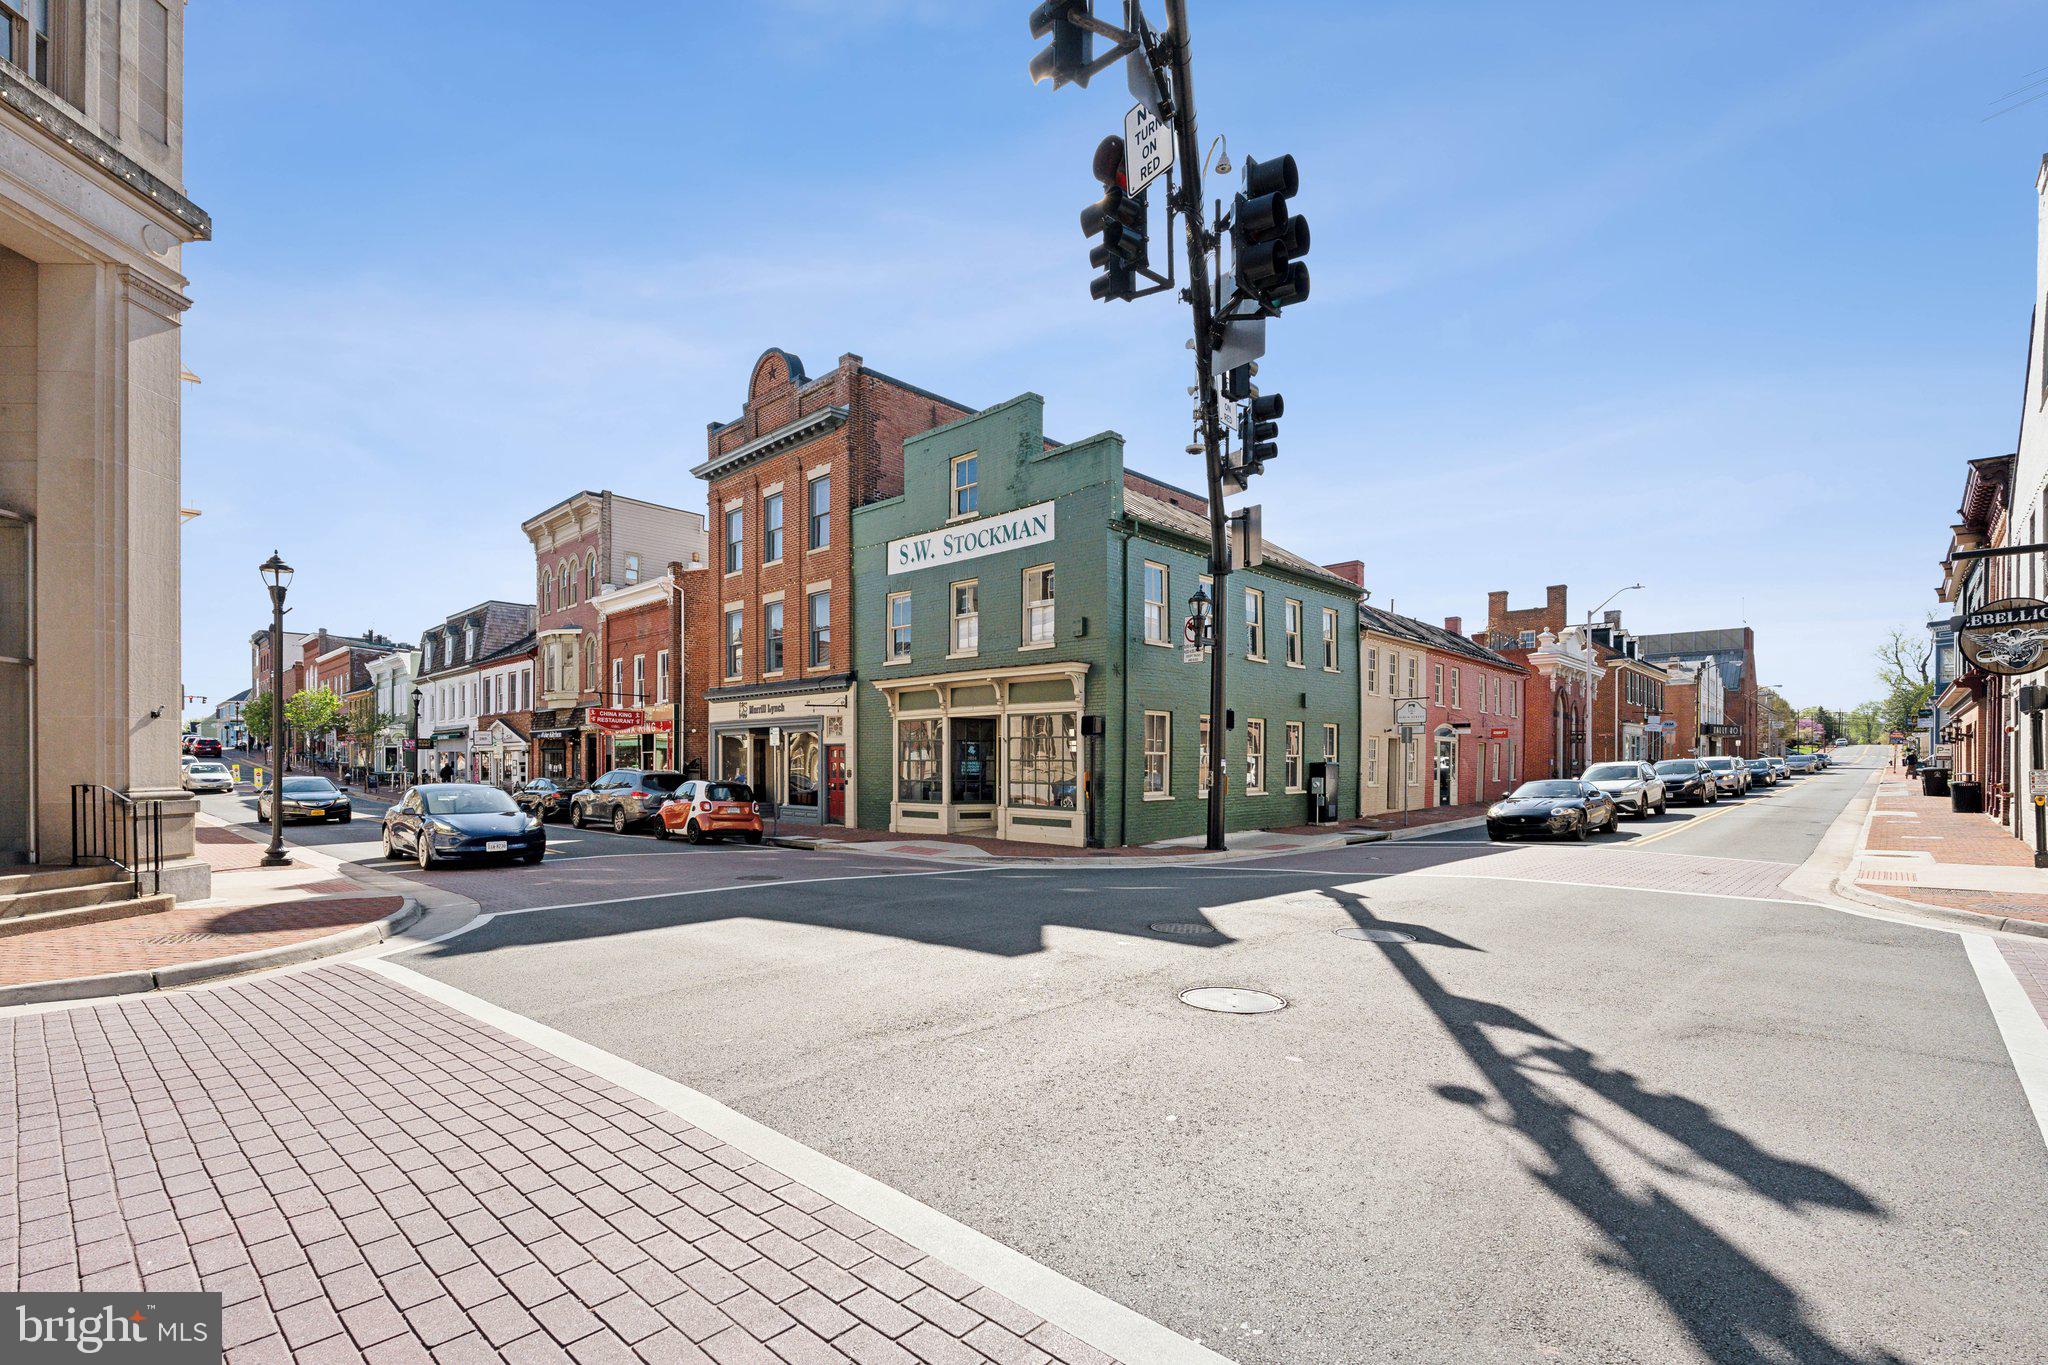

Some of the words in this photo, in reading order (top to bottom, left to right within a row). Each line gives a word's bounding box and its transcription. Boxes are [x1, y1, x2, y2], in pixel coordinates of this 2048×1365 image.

[1137, 107, 1151, 125] N
[1142, 138, 1157, 159] ON
[1140, 156, 1160, 181] RED
[899, 538, 935, 565] S.W.
[943, 514, 1047, 556] STOCKMAN
